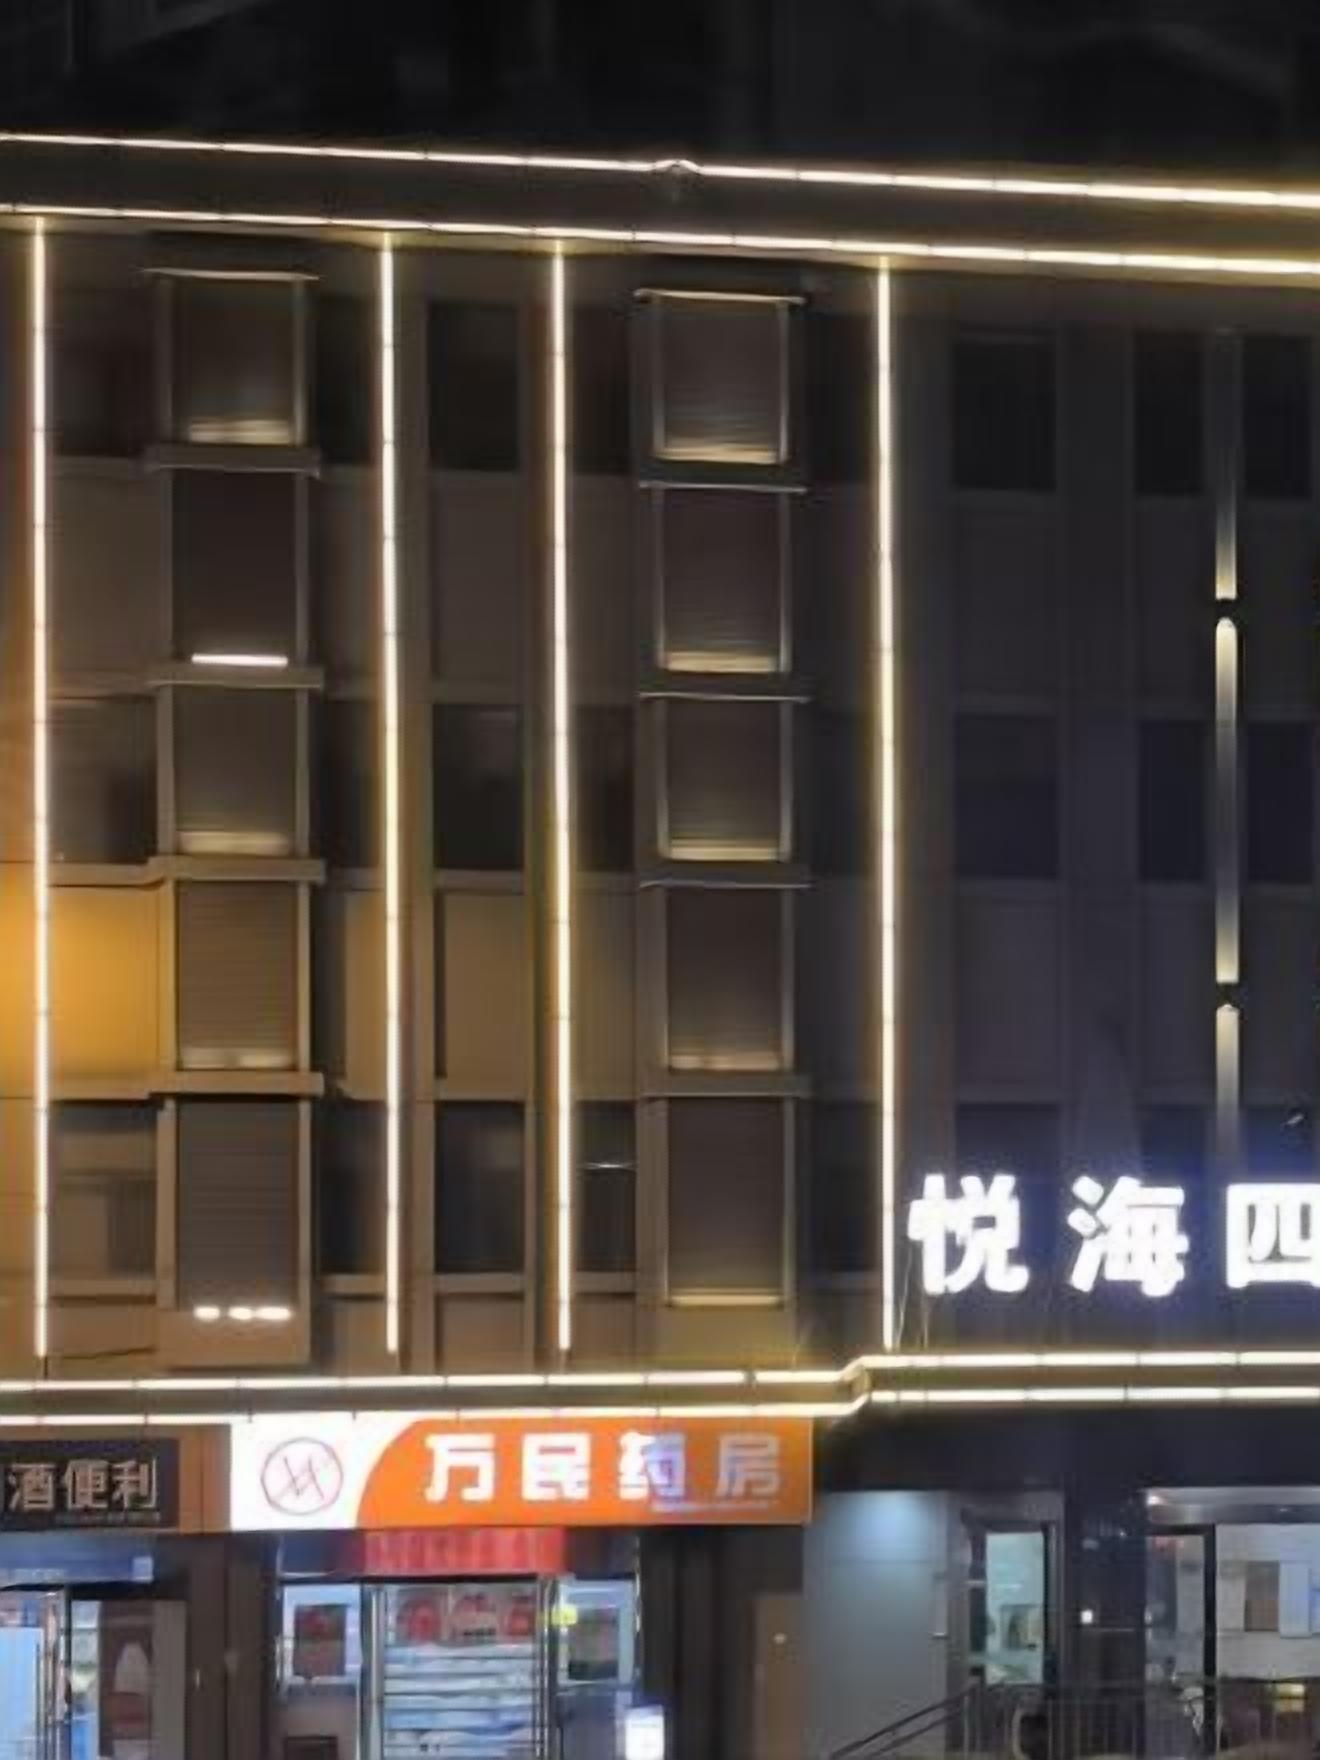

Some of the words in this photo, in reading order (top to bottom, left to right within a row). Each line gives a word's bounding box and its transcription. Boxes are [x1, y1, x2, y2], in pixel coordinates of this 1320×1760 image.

[8, 1458, 158, 1512] 酒便利
[425, 1431, 780, 1503] 万民药房
